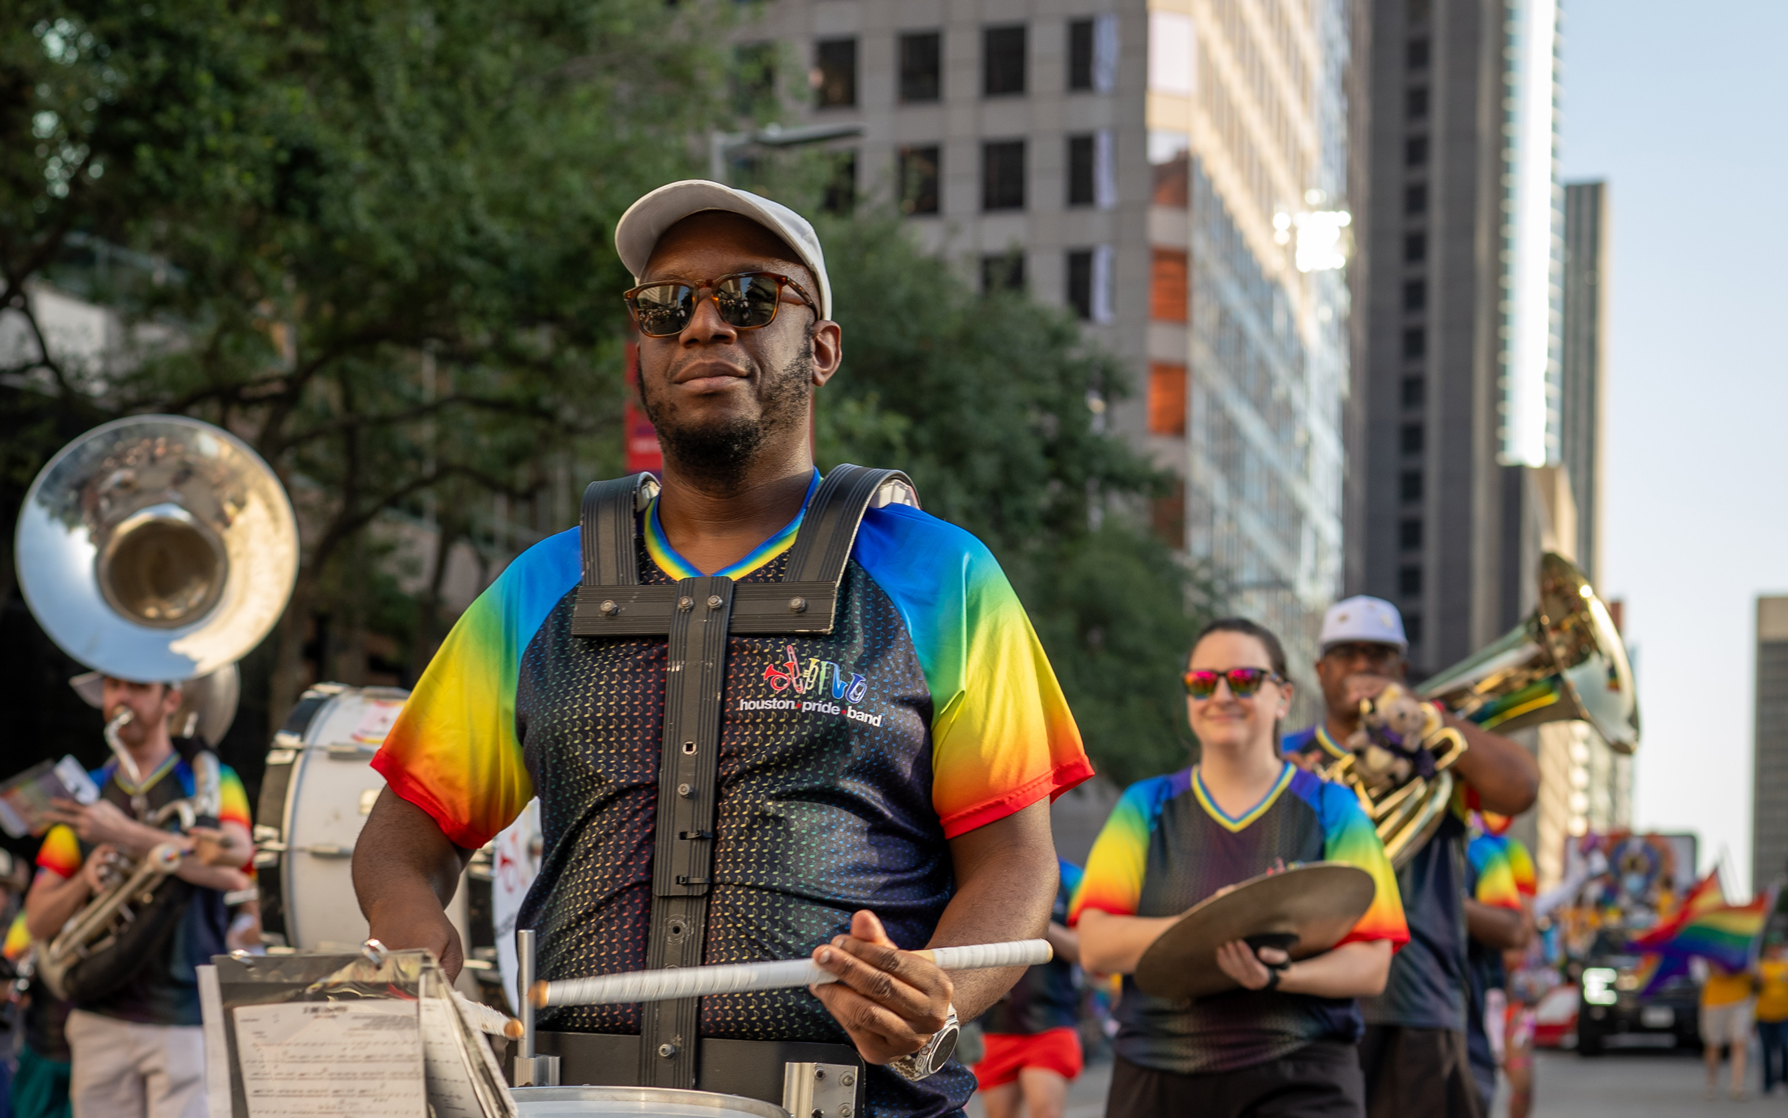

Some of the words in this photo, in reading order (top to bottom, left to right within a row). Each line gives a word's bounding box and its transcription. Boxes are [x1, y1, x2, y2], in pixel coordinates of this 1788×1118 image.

[739, 698, 795, 711] houston
[801, 700, 841, 715] pride
[846, 705, 882, 727] band
